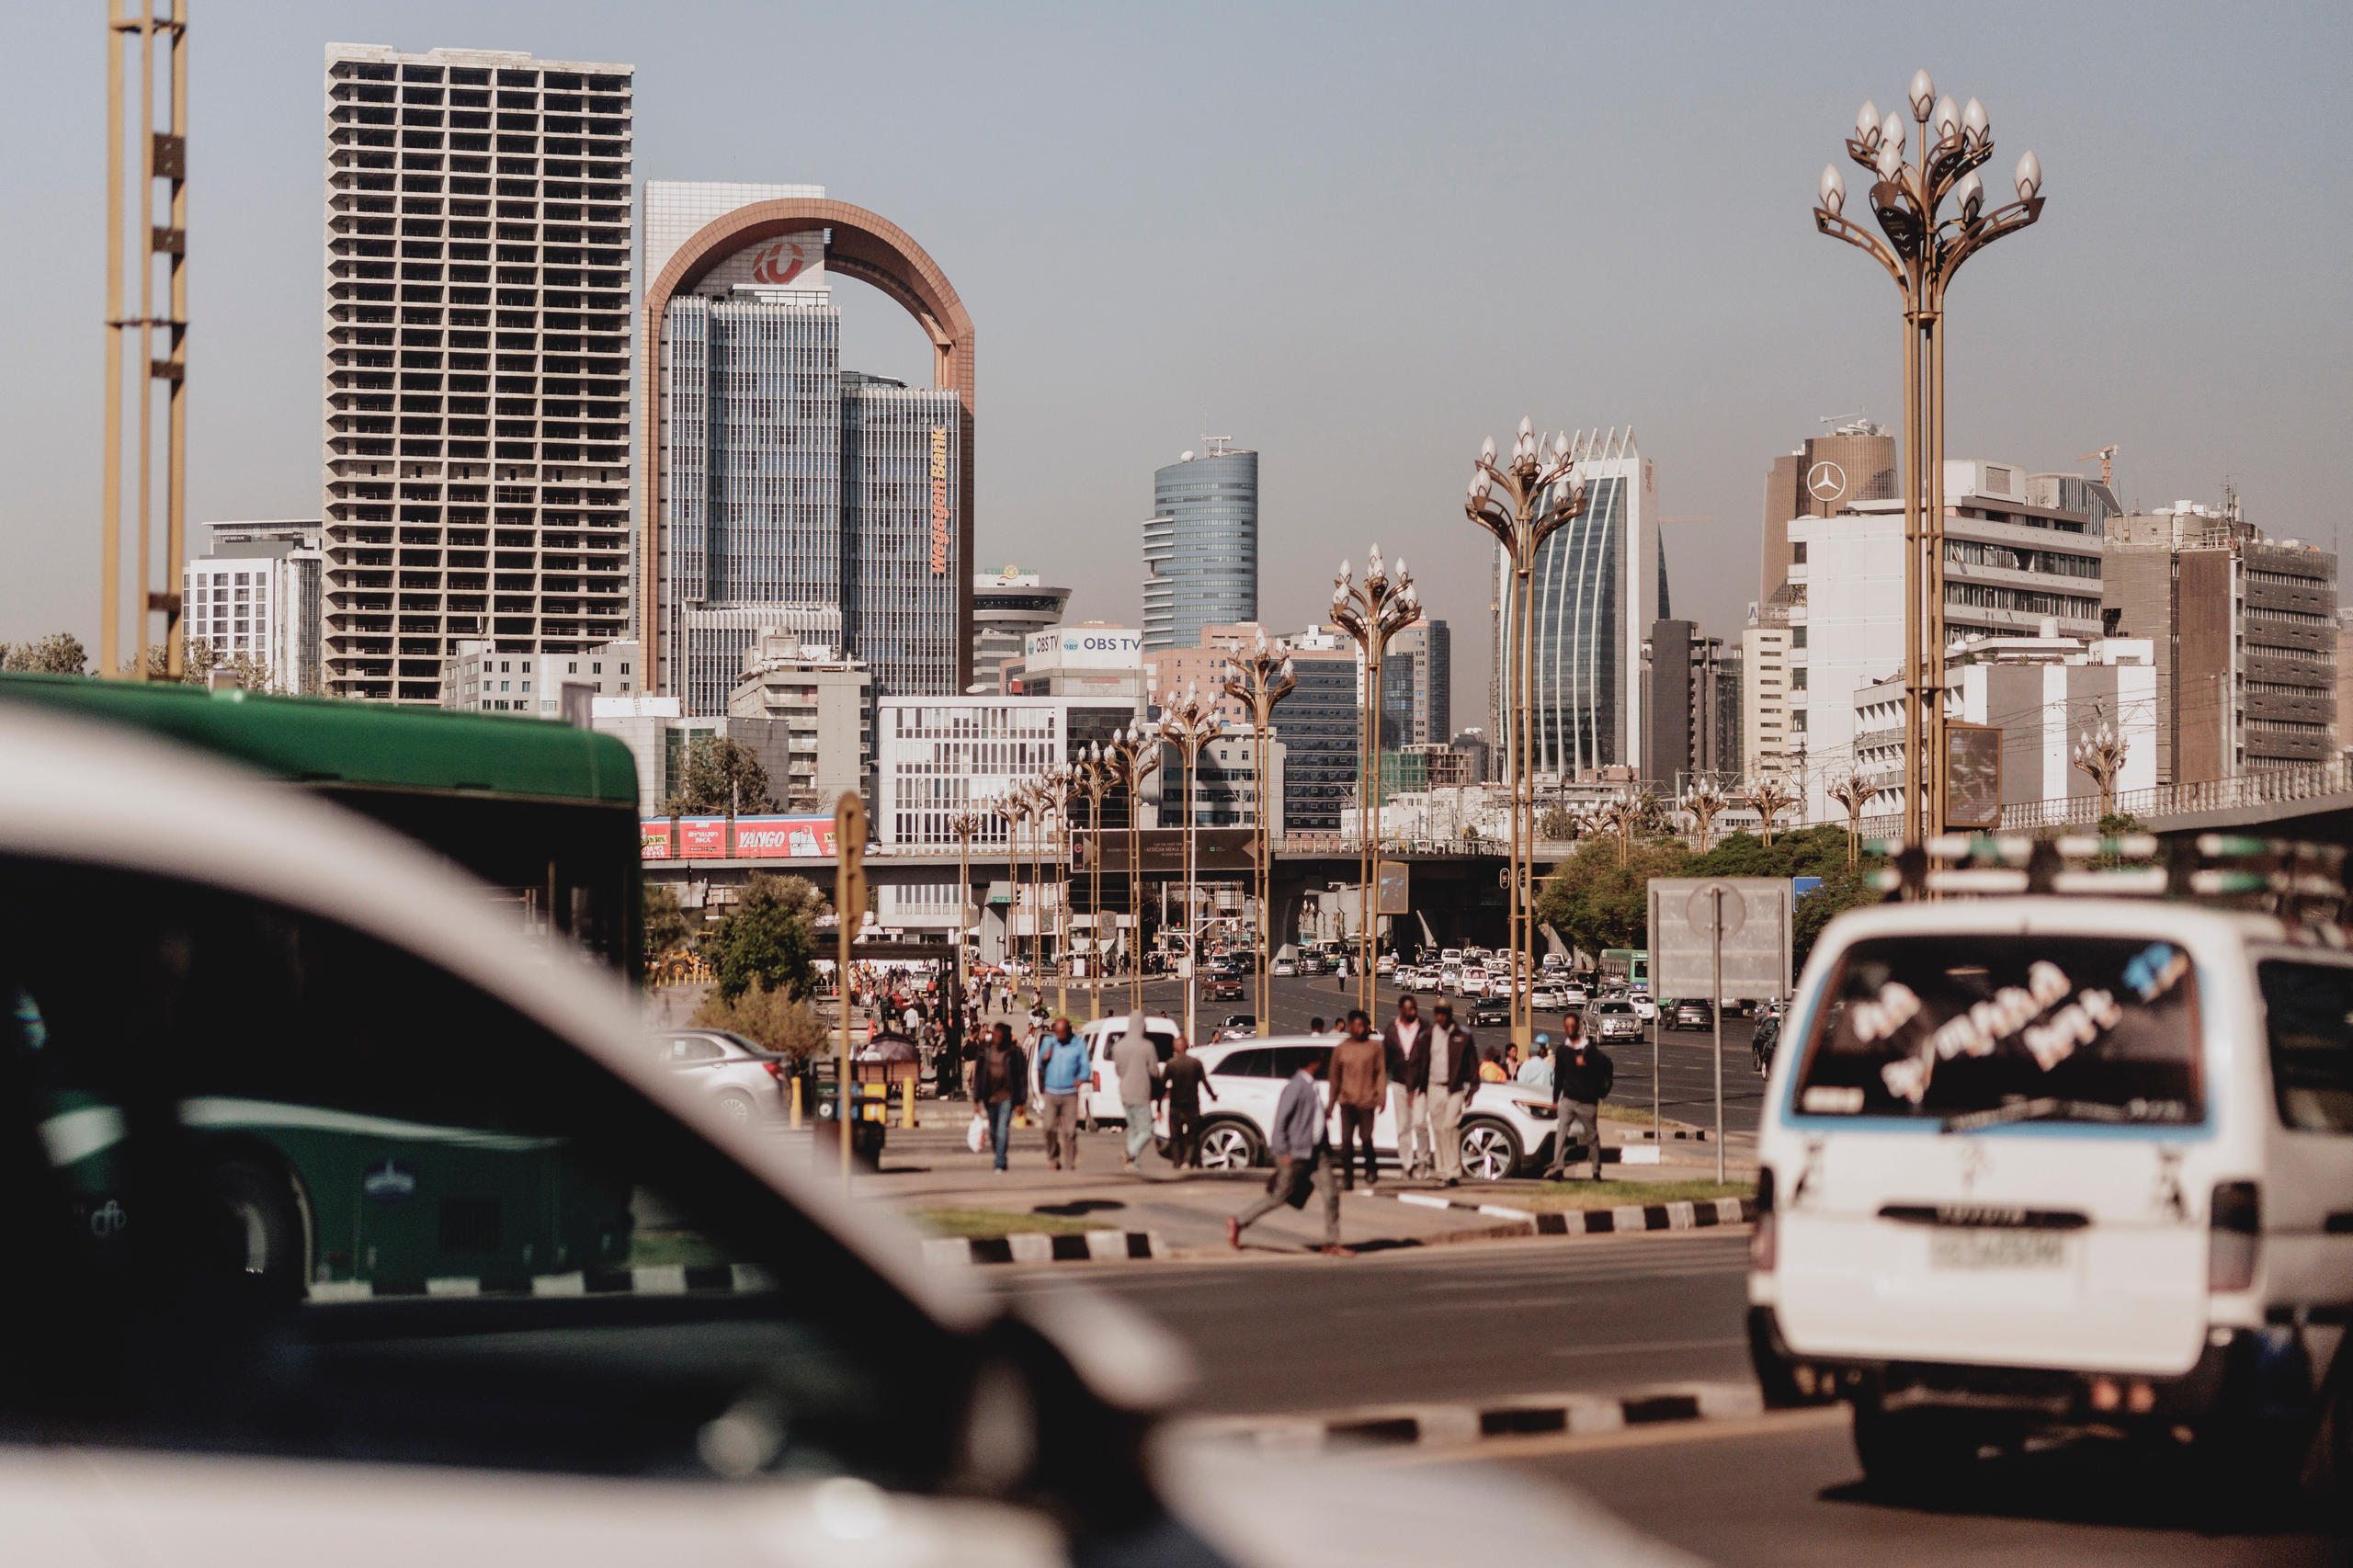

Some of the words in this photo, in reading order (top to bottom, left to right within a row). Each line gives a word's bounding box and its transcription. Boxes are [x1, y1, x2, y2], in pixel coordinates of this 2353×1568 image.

[930, 426, 947, 479] Bank
[930, 480, 949, 574] Wegagen
[1036, 636, 1049, 653] OBS
[1050, 634, 1060, 652] TV
[1084, 637, 1117, 651] OBS
[1120, 638, 1142, 651] TV
[738, 831, 785, 848] YANGO
